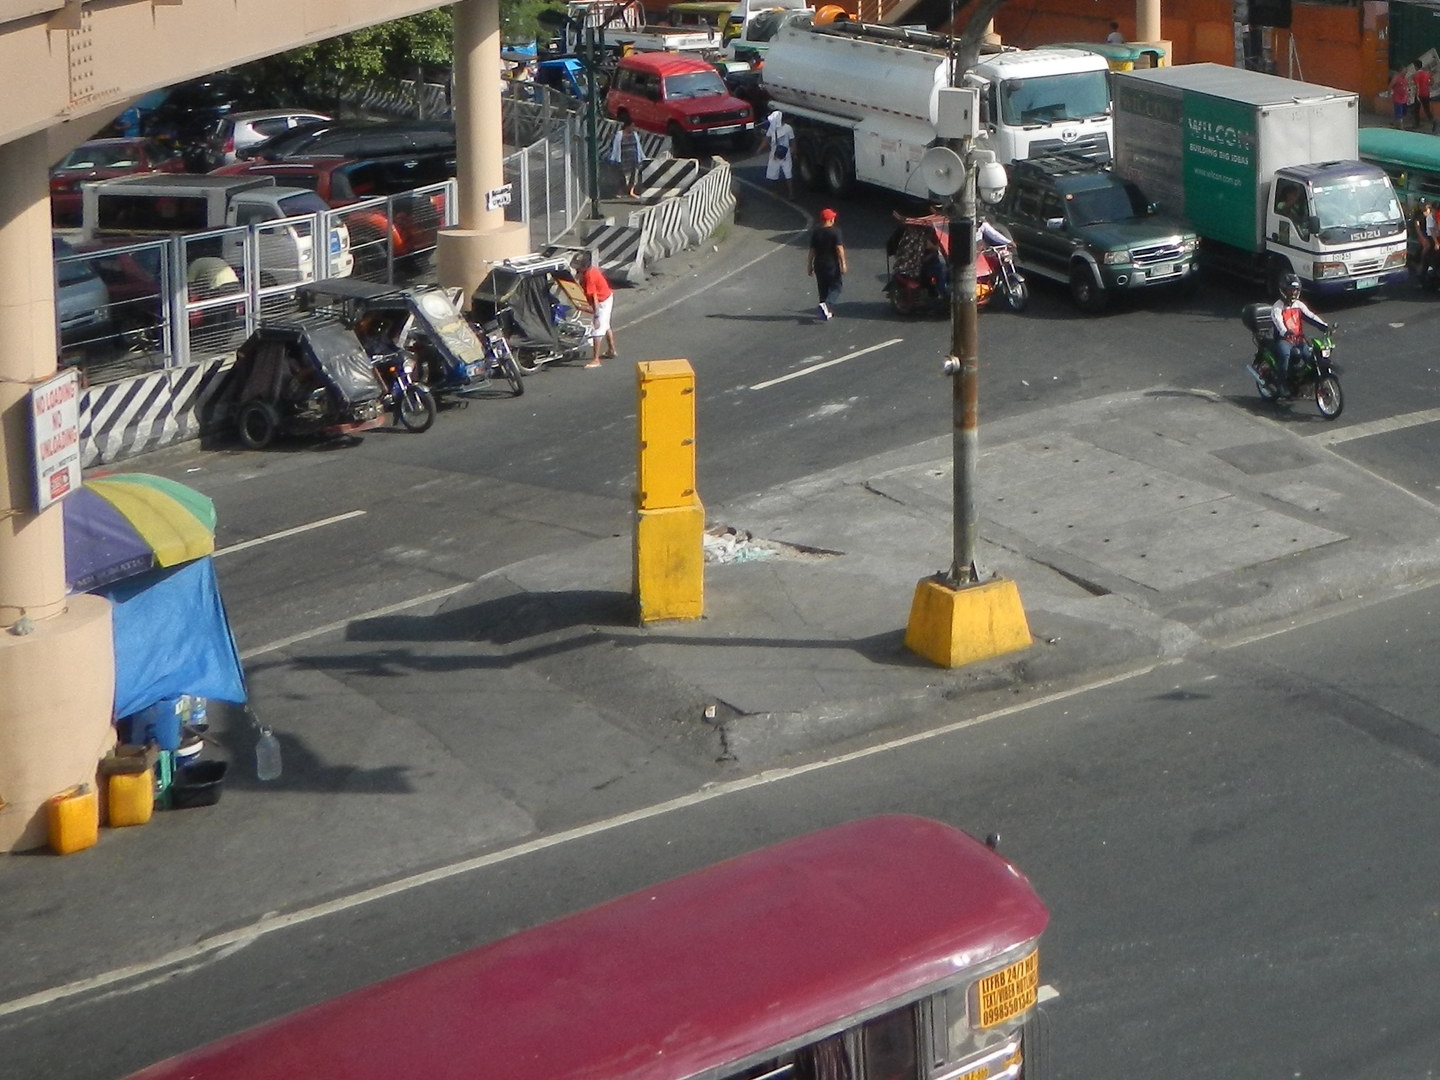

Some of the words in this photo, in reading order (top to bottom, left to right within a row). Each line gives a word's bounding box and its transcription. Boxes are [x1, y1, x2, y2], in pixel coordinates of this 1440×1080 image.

[1188, 118, 1249, 150] WILCON
[1189, 143, 1218, 157] BUILDING
[1231, 154, 1249, 165] IDEAS
[1351, 230, 1381, 241] ISUZU
[36, 395, 45, 416] NO
[46, 382, 75, 410] LOADING
[52, 410, 62, 429] NO
[40, 426, 77, 460] UNLOADING
[982, 972, 1006, 993] LTFRB
[1007, 961, 1024, 982] 24/7
[983, 983, 1015, 1010] TEXT/VIBER
